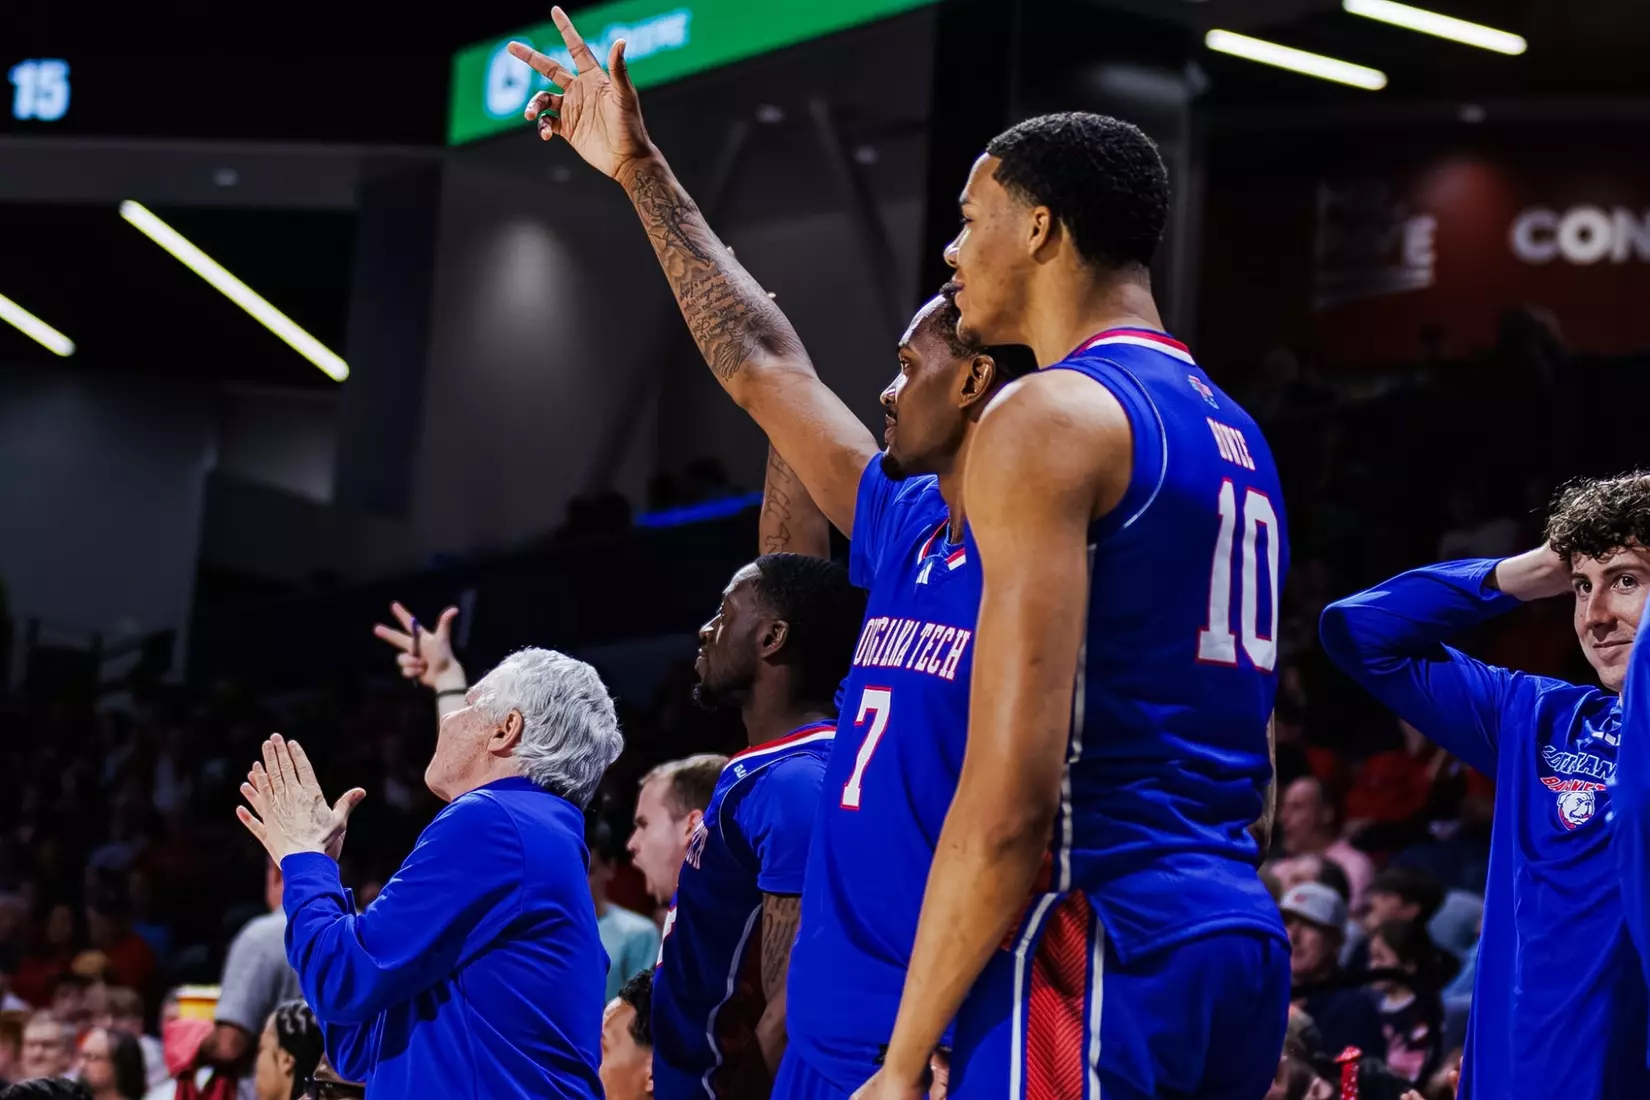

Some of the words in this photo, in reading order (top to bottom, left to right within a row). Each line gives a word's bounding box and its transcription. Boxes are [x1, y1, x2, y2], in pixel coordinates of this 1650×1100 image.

[8, 59, 71, 121] 15
[1195, 476, 1279, 673] 10
[905, 621, 972, 681] TECH
[840, 685, 892, 811] 7
